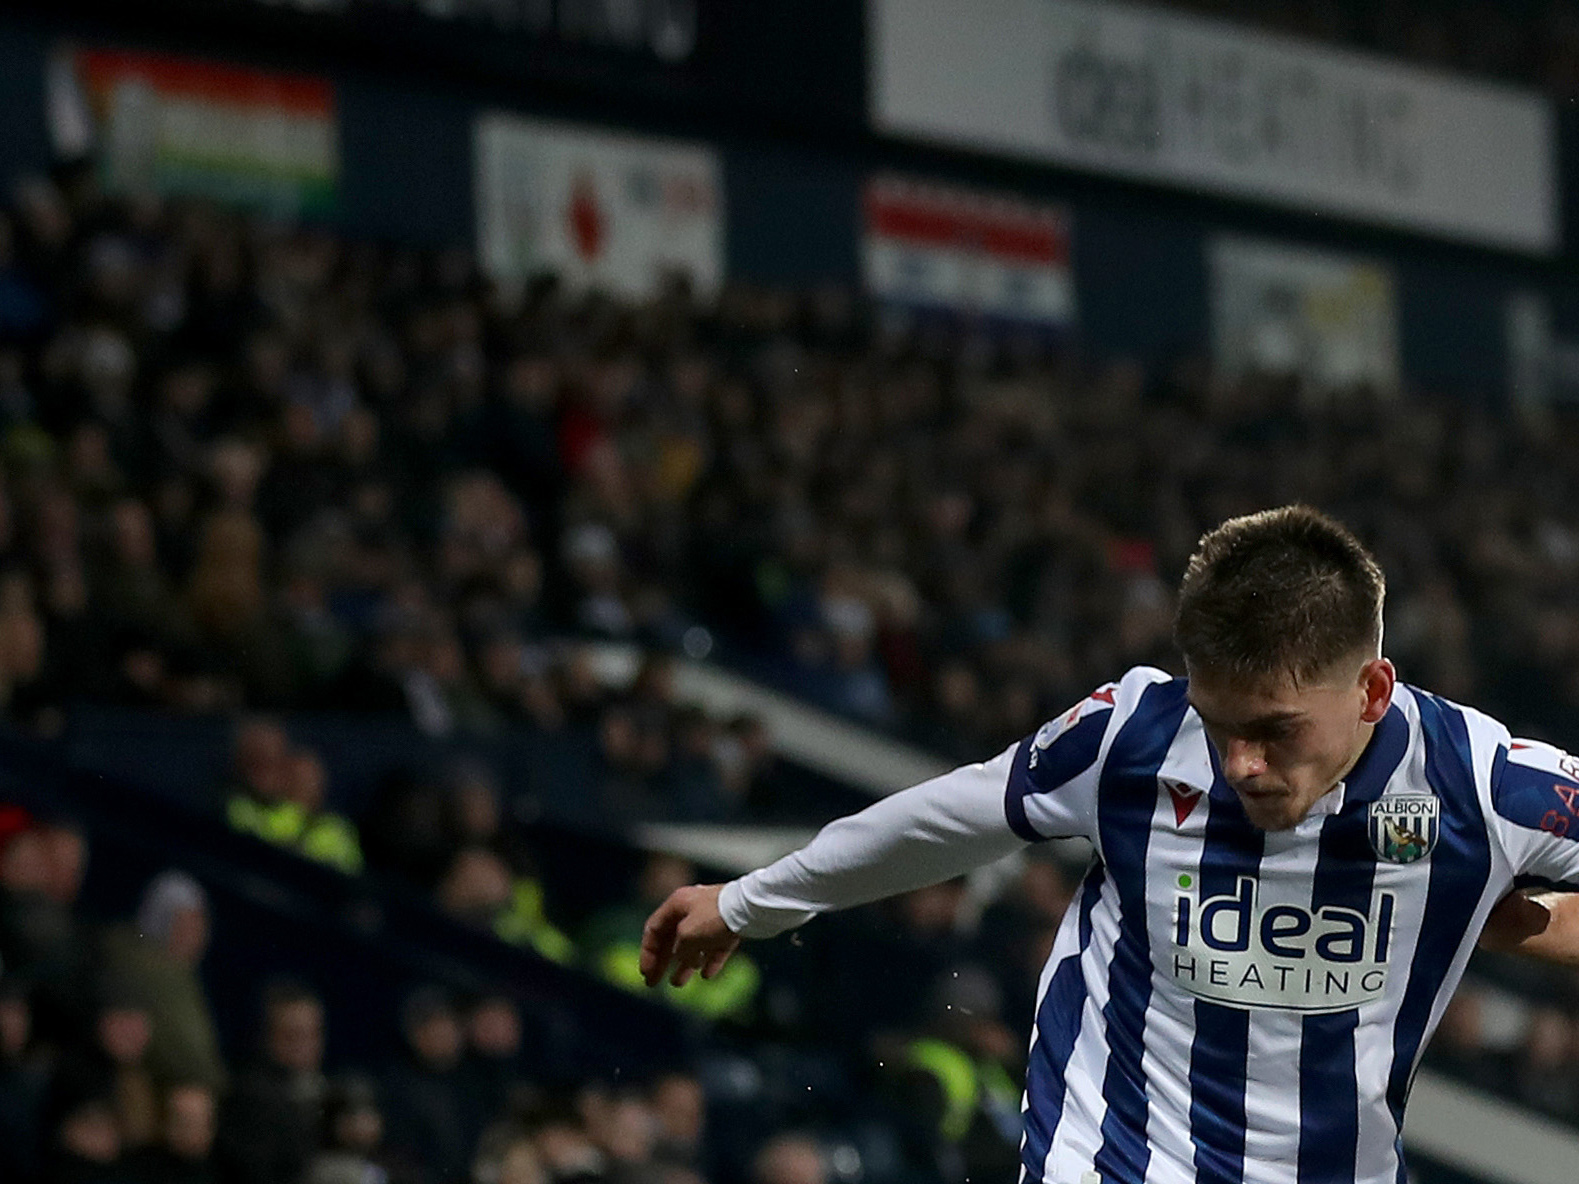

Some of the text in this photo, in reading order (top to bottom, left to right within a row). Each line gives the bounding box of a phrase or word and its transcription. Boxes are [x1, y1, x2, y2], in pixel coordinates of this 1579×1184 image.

[1374, 802, 1433, 814] ALBION
[1176, 873, 1394, 965] ideal
[1174, 954, 1384, 995] HEATING
